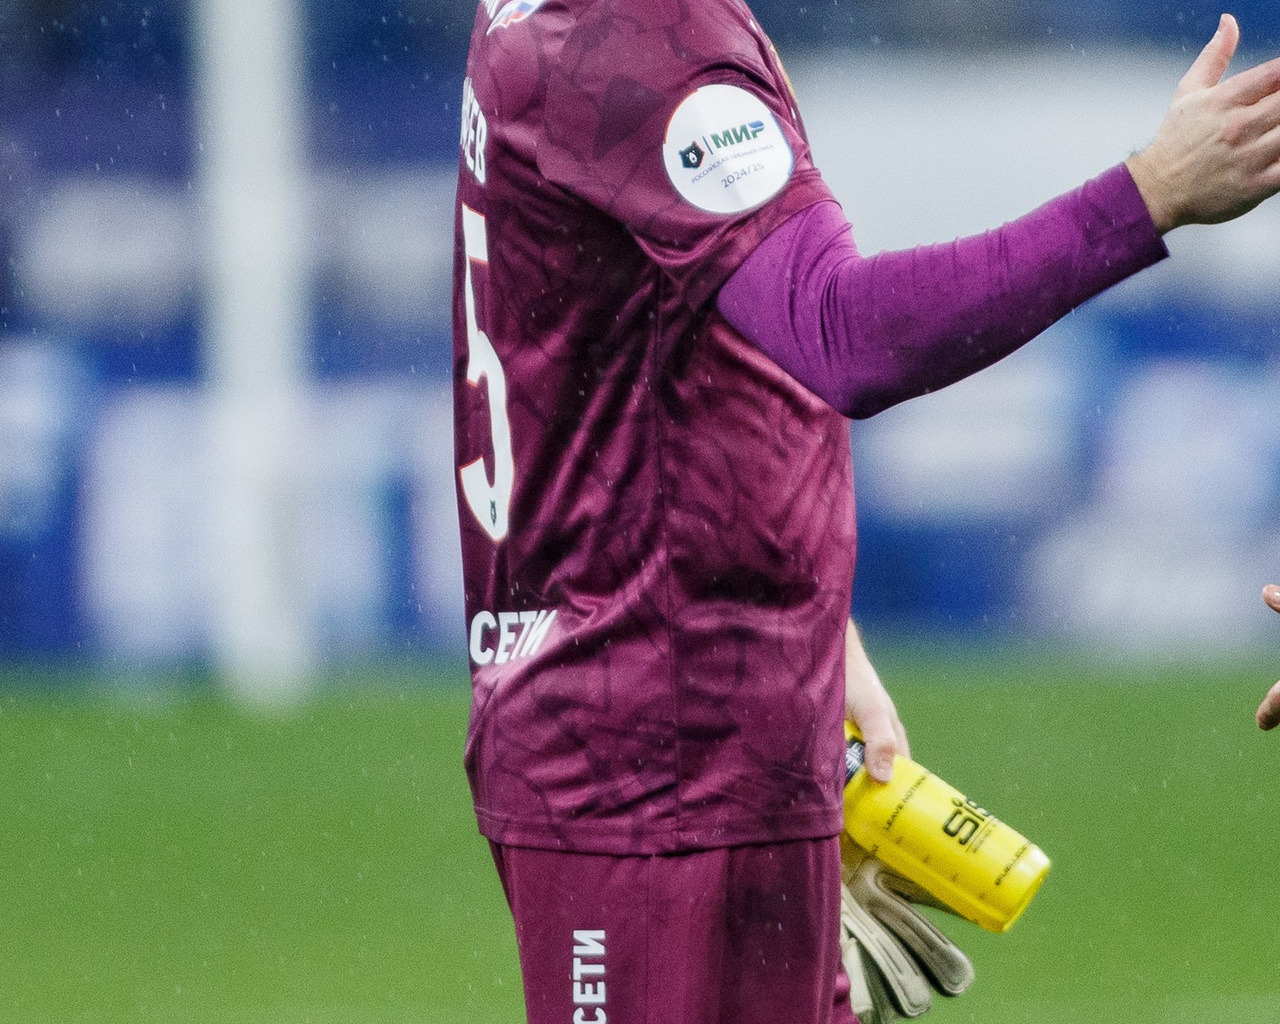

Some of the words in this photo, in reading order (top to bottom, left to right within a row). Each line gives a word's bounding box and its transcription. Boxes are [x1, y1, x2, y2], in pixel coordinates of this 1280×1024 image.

[710, 120, 765, 149] МИР
[720, 162, 765, 189] 2024/25
[469, 609, 558, 665] СЕТИ
